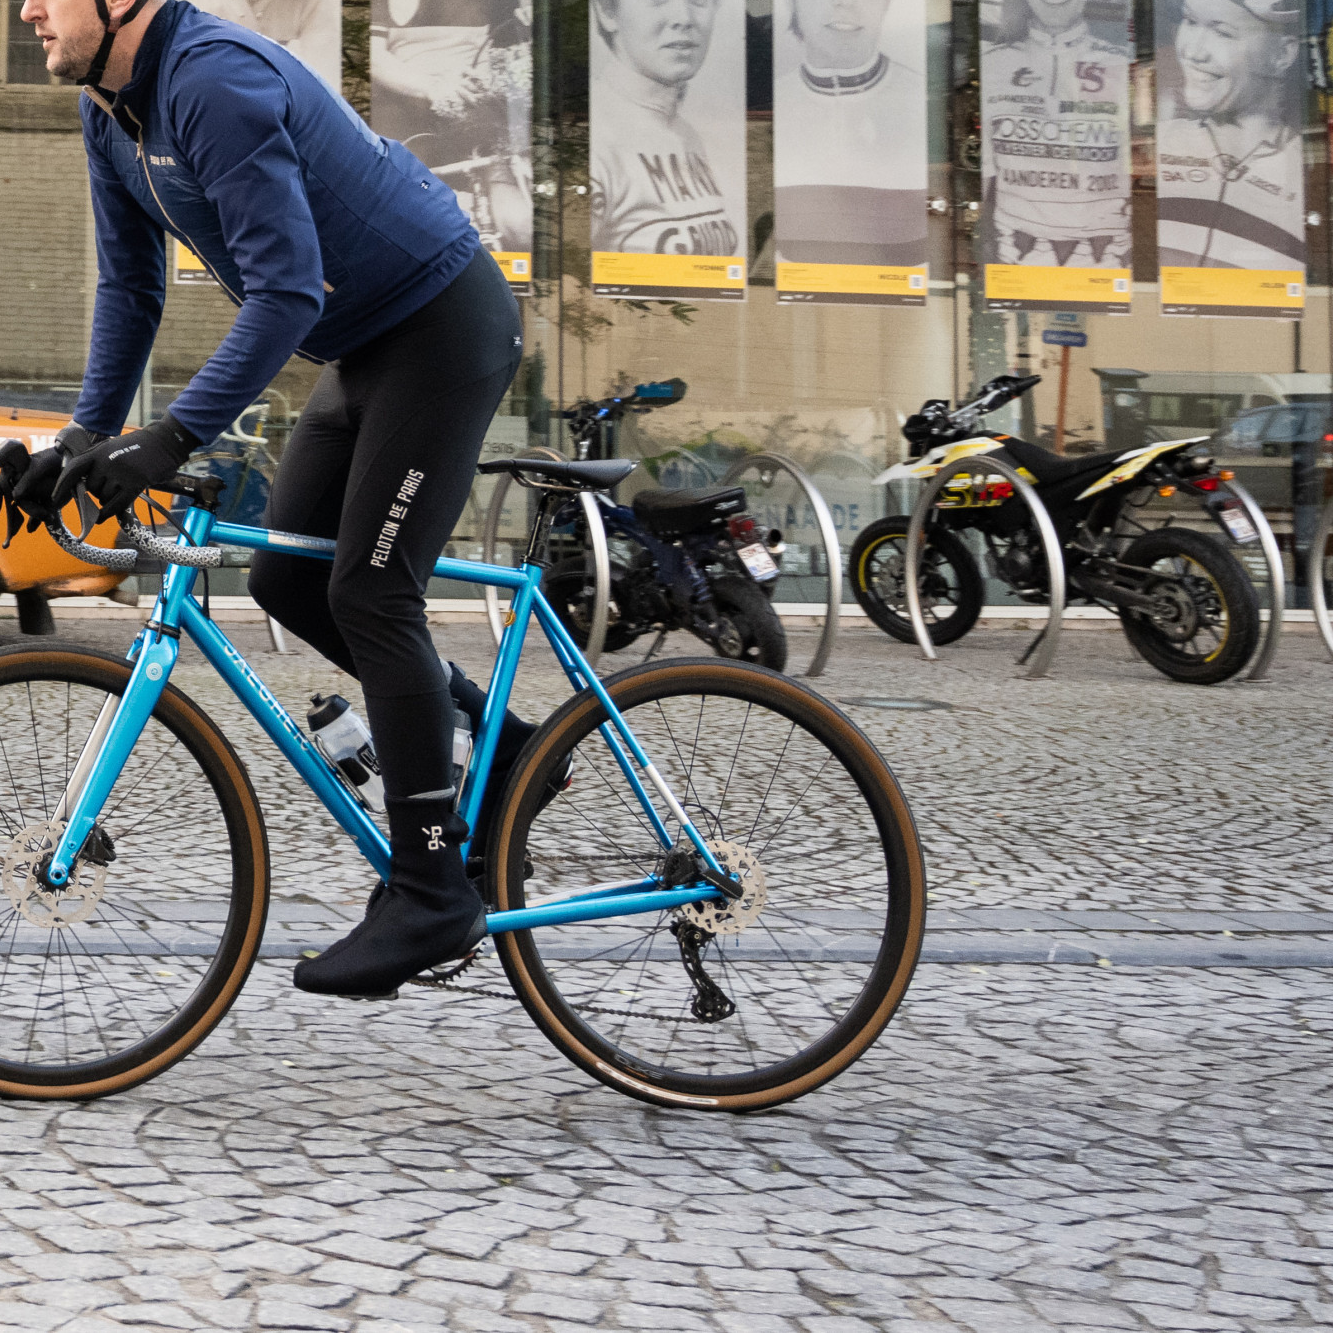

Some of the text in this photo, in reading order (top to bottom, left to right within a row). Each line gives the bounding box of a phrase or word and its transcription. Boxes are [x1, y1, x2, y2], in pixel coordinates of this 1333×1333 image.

[370, 468, 424, 568] PELOTON DE PARIS
